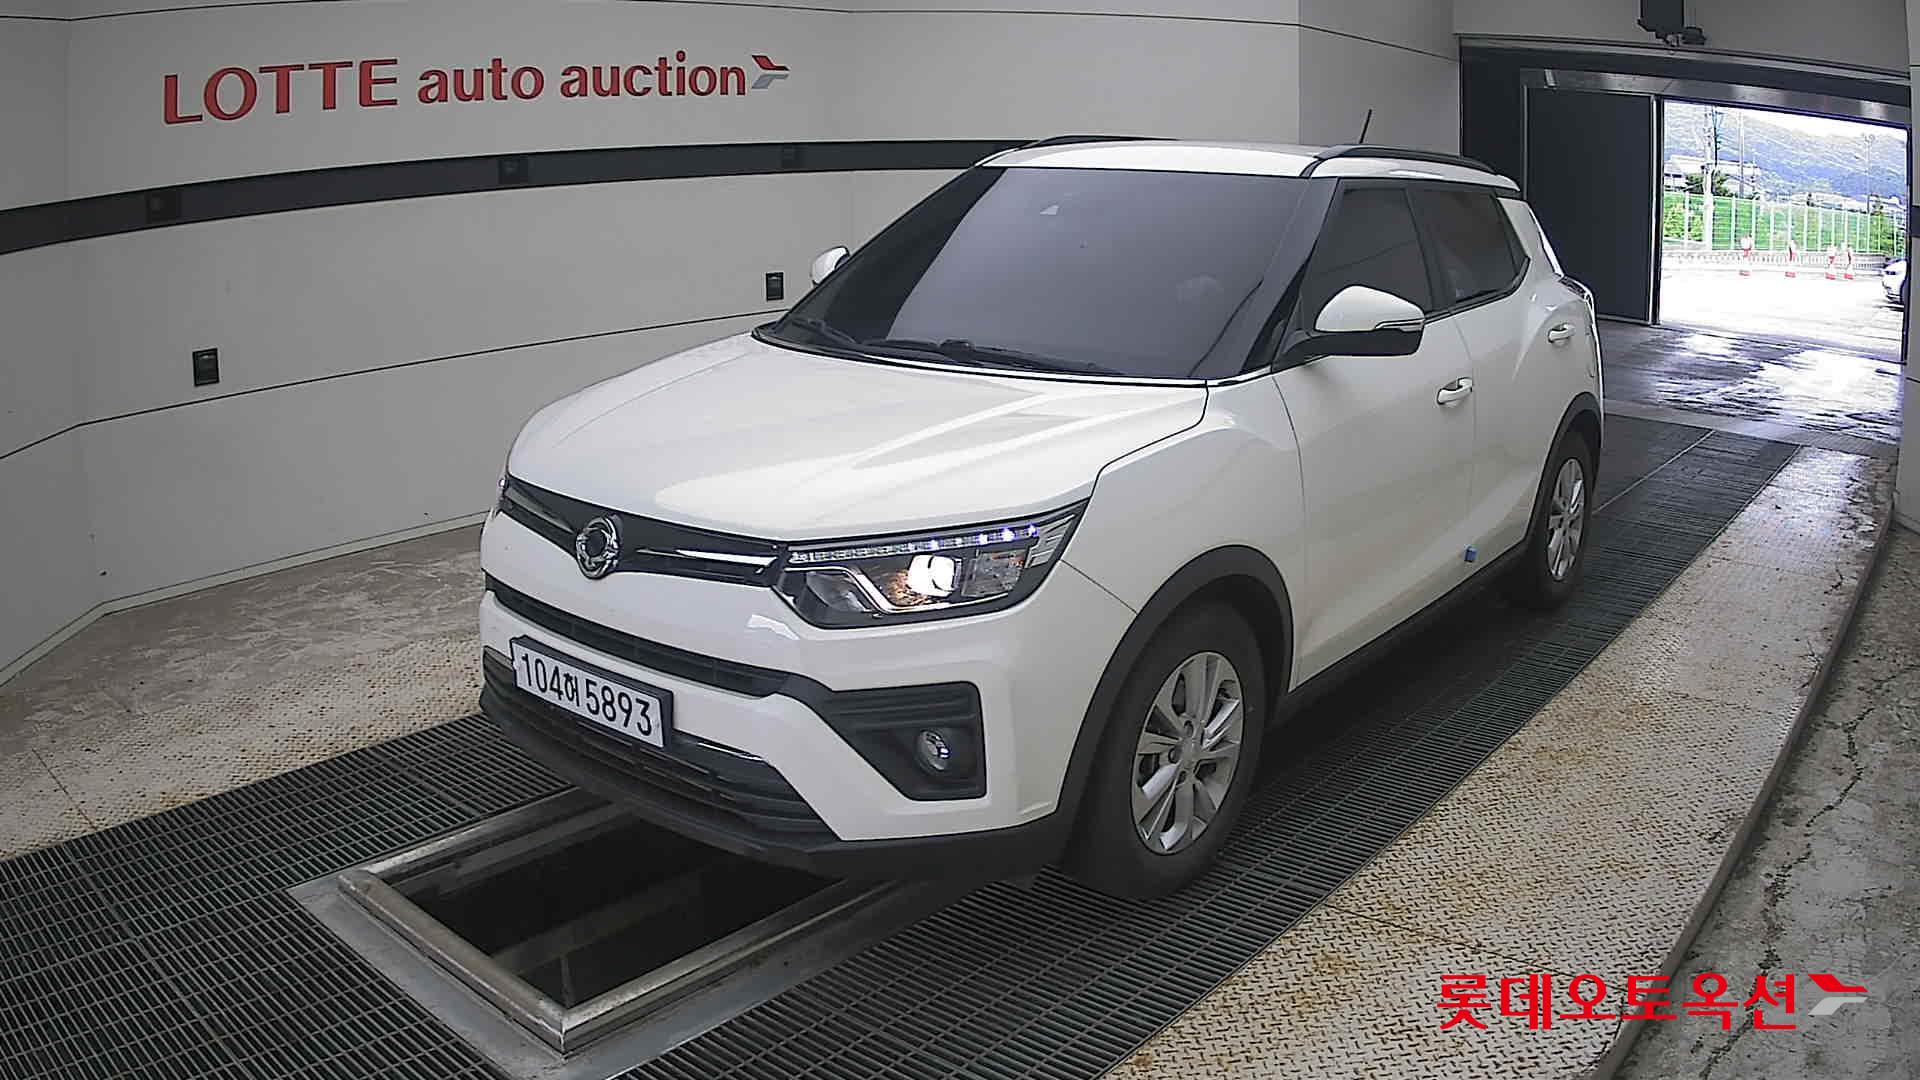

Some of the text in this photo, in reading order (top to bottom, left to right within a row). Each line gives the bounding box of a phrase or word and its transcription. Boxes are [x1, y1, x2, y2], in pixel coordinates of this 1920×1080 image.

[163, 50, 747, 125] LOTTE auto auction
